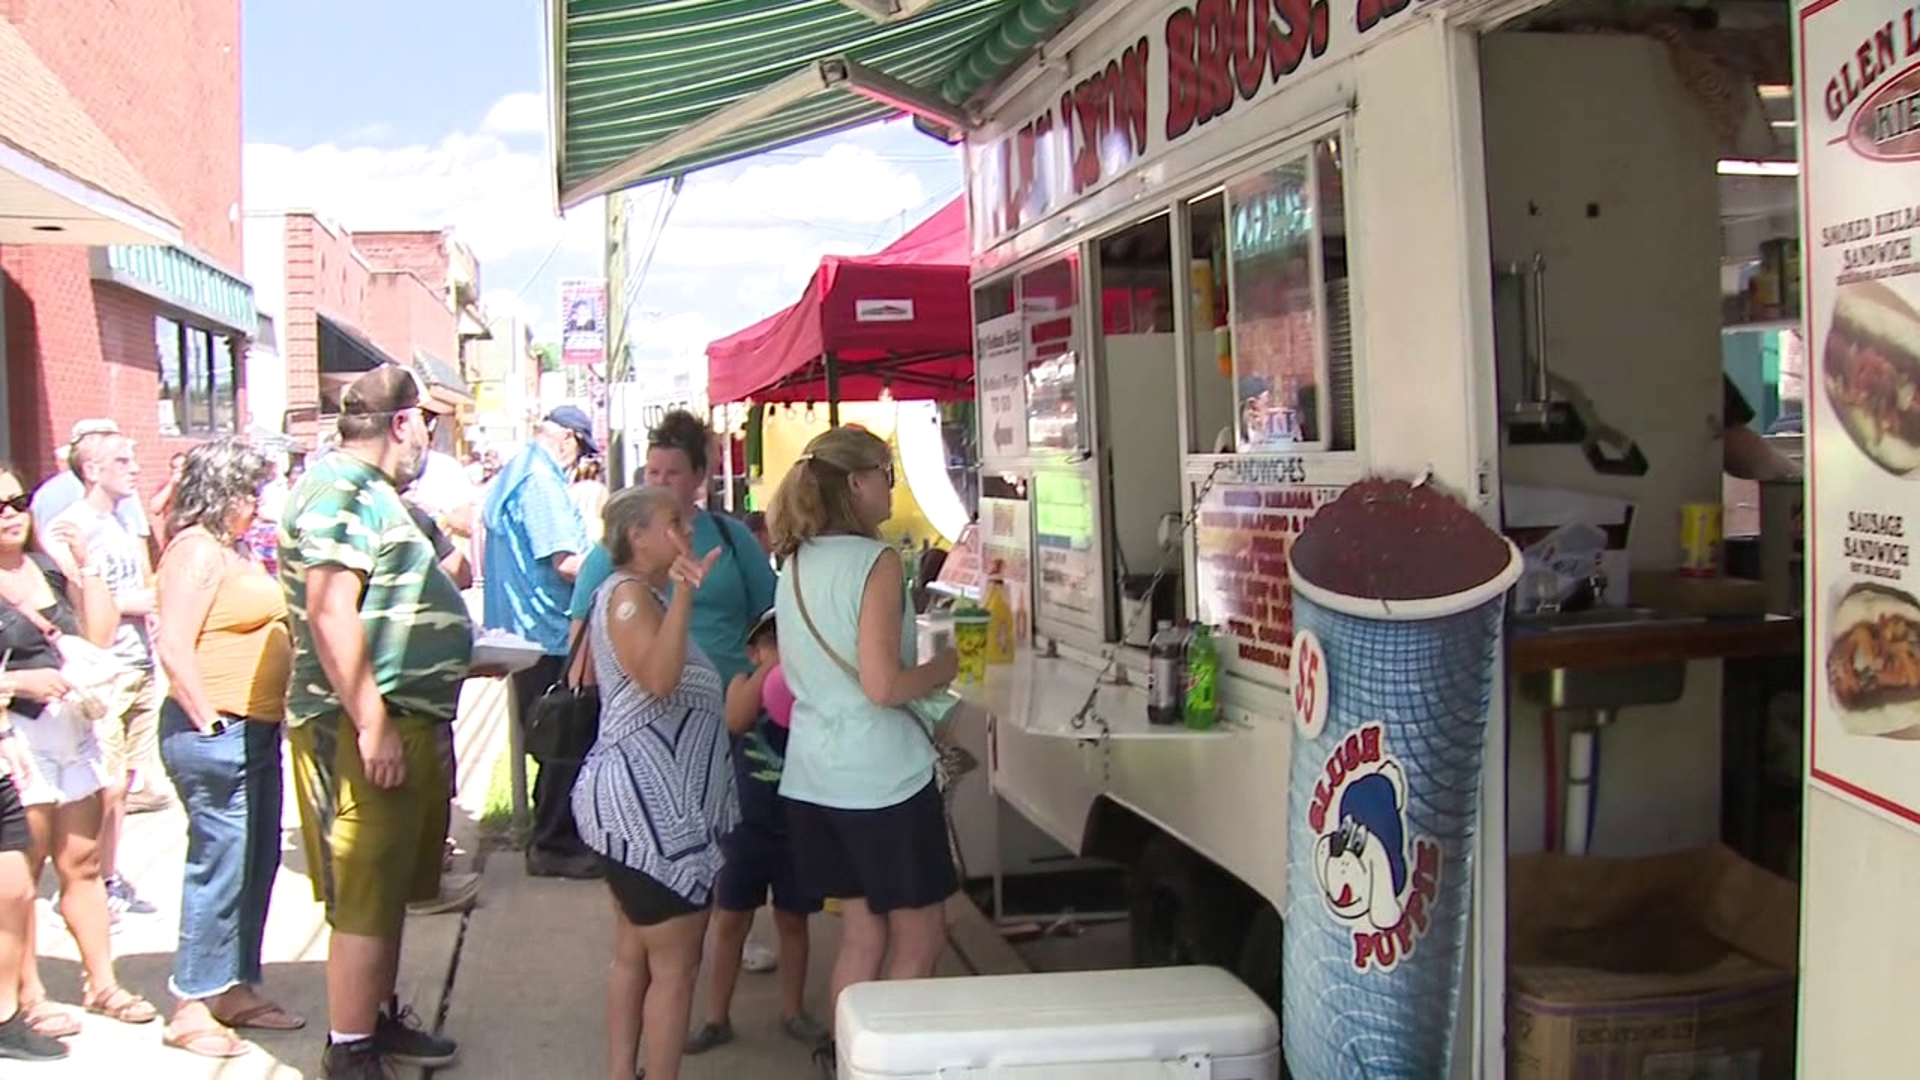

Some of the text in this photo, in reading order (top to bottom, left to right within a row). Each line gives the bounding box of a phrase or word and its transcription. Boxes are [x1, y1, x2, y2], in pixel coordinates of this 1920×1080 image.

[1061, 35, 1149, 197] LYON
[1166, 0, 1330, 142] BROS.
[1825, 20, 1896, 122] GLEN
[1822, 217, 1872, 248] SMOKED
[1843, 237, 1912, 270] SANDWICH
[1843, 536, 1910, 567] SANDWICH
[1848, 510, 1904, 537] SAUSAGE
[1295, 637, 1319, 725] $5
[1309, 725, 1381, 835] SLUSH
[1353, 840, 1440, 969] PUPPIE
